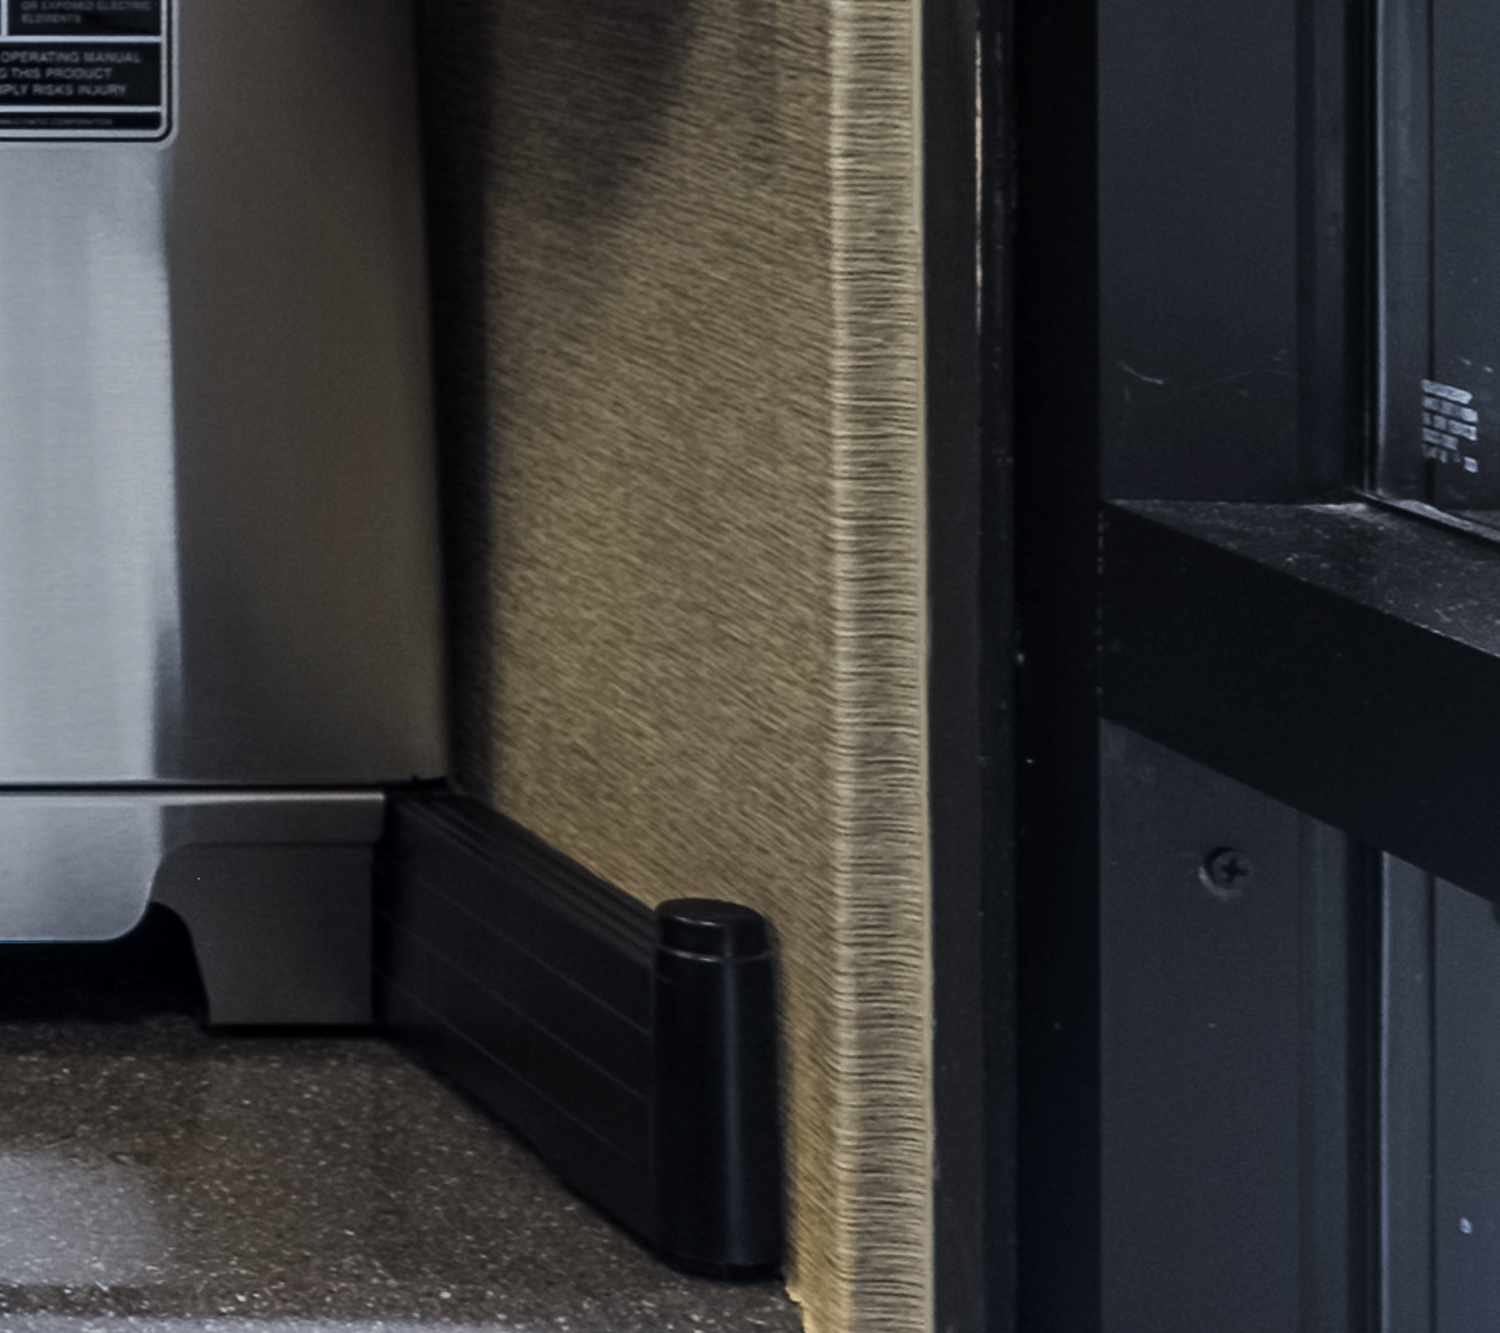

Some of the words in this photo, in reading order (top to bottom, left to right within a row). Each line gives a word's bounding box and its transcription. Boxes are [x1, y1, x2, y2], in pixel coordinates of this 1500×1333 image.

[0, 51, 80, 63] OPERATING
[83, 51, 142, 63] MANUAL
[11, 67, 41, 79] THIS
[45, 67, 112, 79] PRODUCT
[32, 84, 74, 96] RISKS
[77, 84, 128, 96] INJURY
